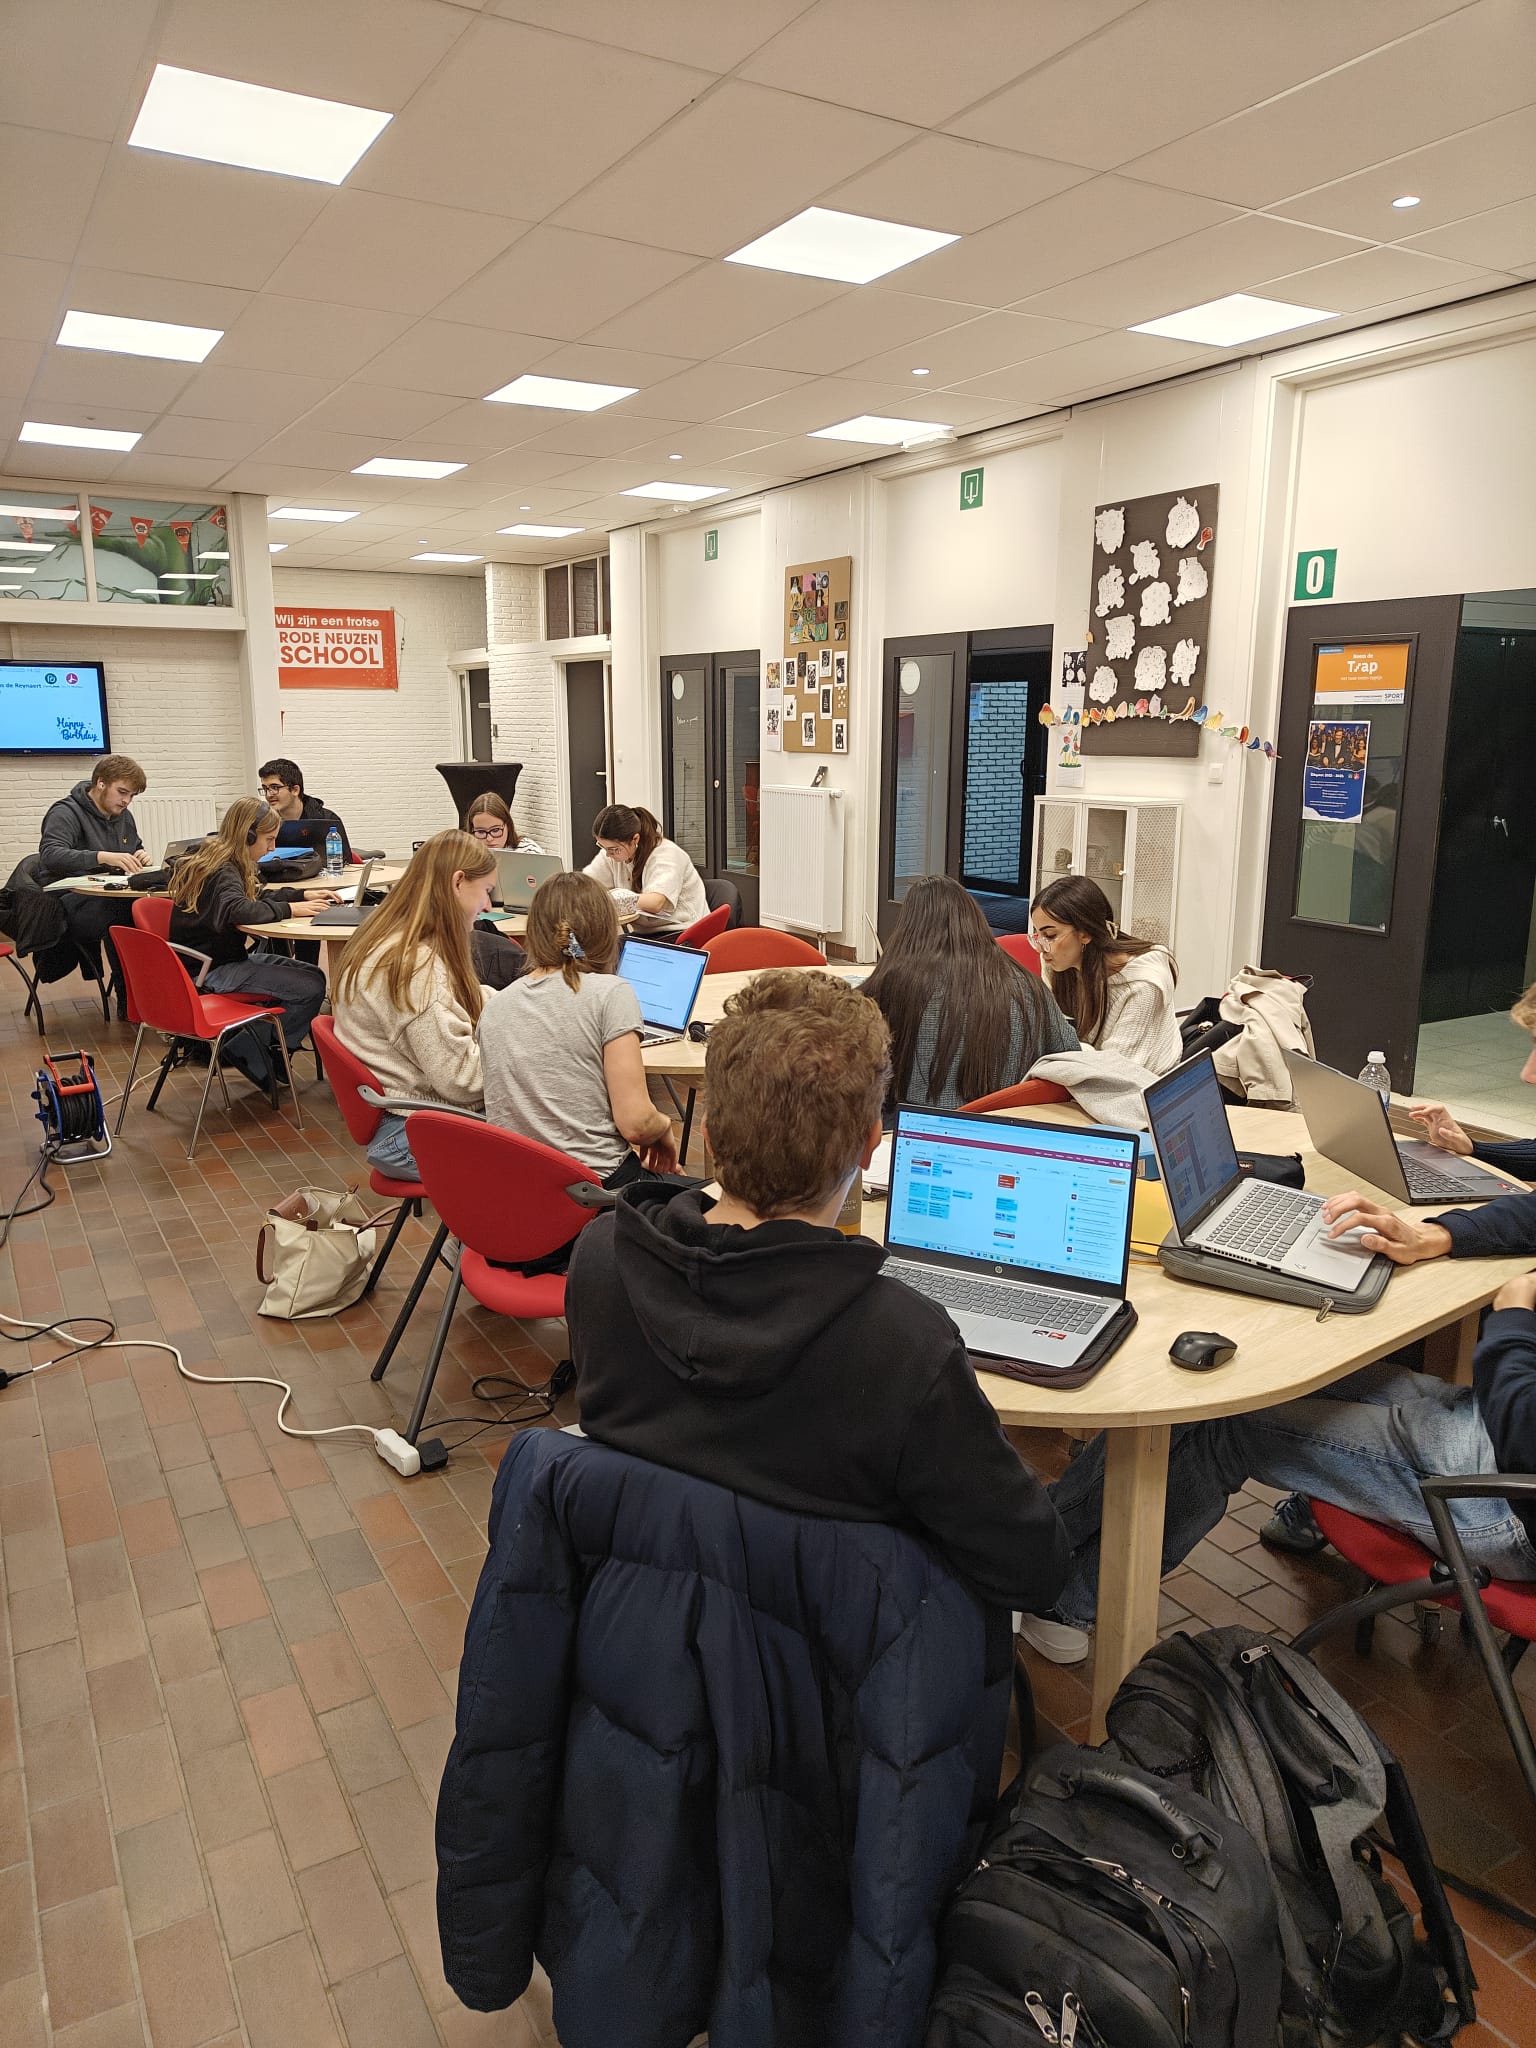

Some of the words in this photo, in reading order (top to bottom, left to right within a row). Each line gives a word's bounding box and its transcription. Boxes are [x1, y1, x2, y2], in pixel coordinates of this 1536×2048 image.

[1305, 555, 1325, 595] 0
[275, 614, 294, 627] Wij
[297, 615, 317, 627] zijn
[321, 617, 343, 626] een
[347, 616, 380, 627] trotse
[279, 631, 320, 644] RODE
[325, 632, 379, 645] NEUZEN
[280, 645, 380, 665] SCHOOL
[56, 717, 86, 730] Happy
[61, 729, 99, 742] Birthday
